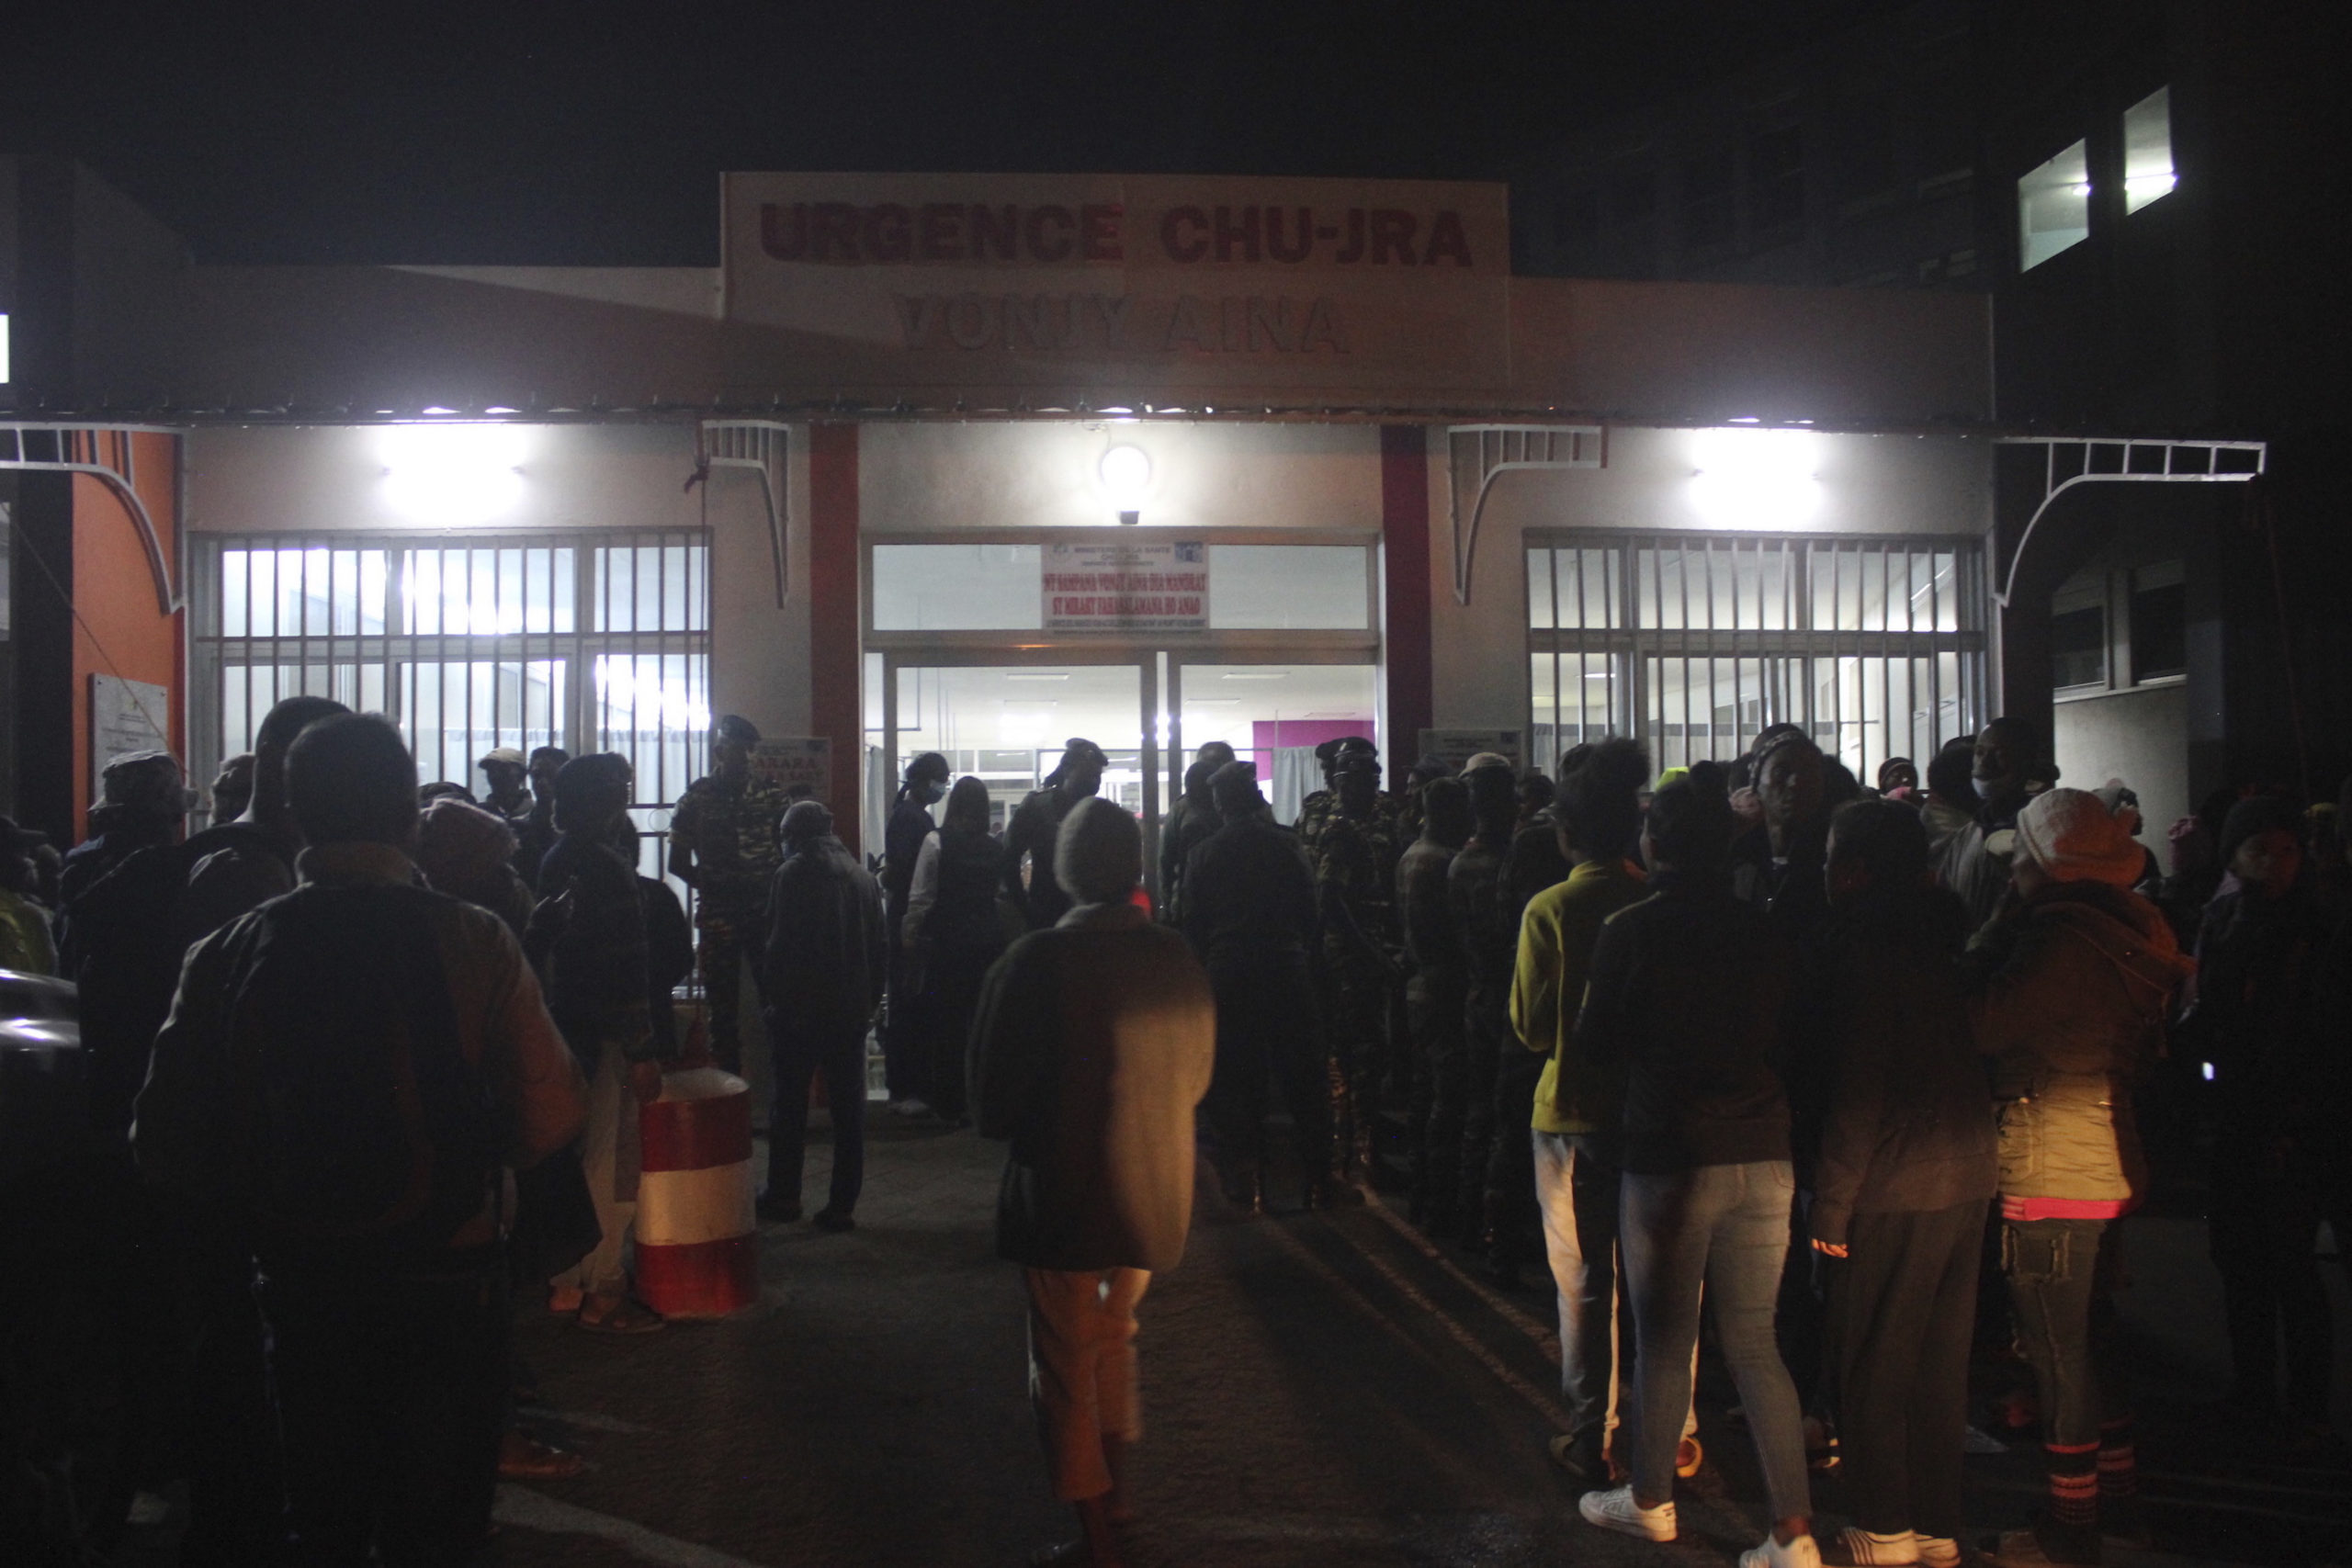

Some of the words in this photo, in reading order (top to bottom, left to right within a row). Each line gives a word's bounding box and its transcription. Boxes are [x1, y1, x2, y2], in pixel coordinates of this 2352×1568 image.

[760, 202, 1125, 263] URGENCE
[1159, 204, 1474, 267] CHU-JRA
[1162, 294, 1351, 355] AINA
